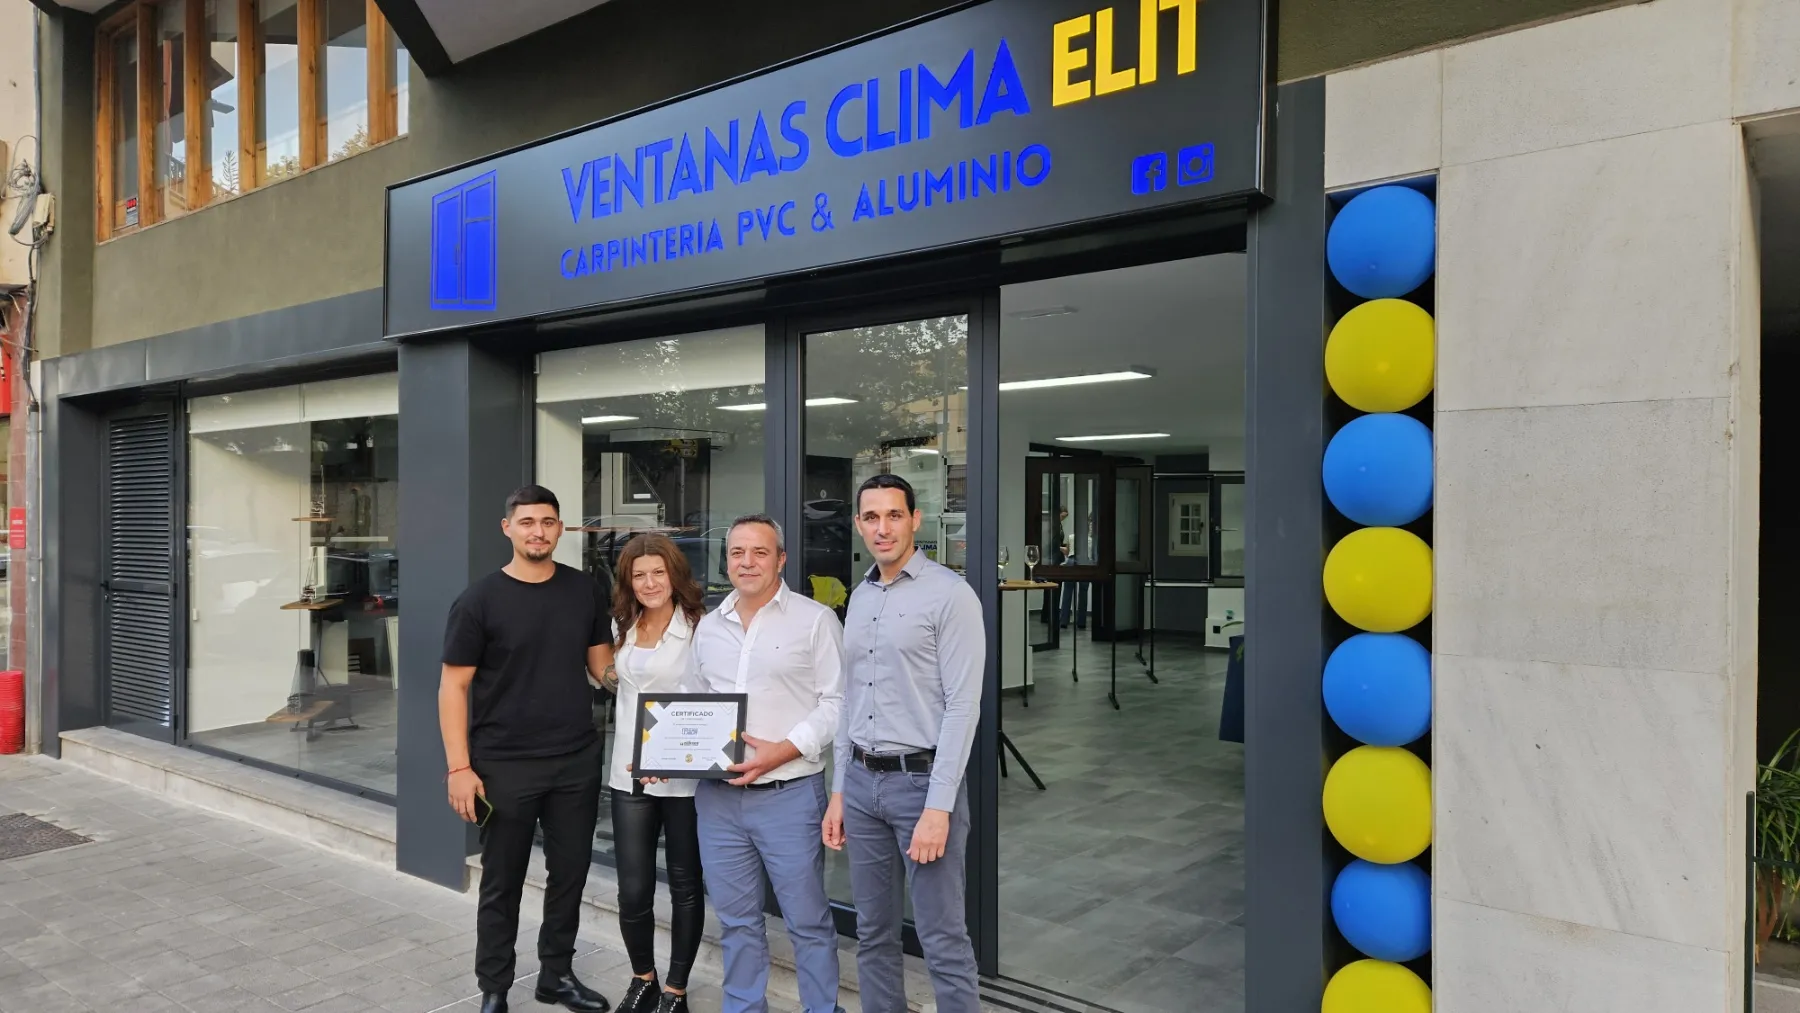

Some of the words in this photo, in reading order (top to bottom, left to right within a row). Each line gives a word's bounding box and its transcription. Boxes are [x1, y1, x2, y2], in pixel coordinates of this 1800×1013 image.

[561, 99, 811, 224] VENTANAS
[824, 38, 1031, 159] CLIMA
[1052, 0, 1198, 107] ELIT
[560, 221, 724, 279] CARPINTERIA
[737, 200, 796, 246] PVC
[811, 192, 835, 232] &
[852, 143, 1053, 222] ALUMINIO
